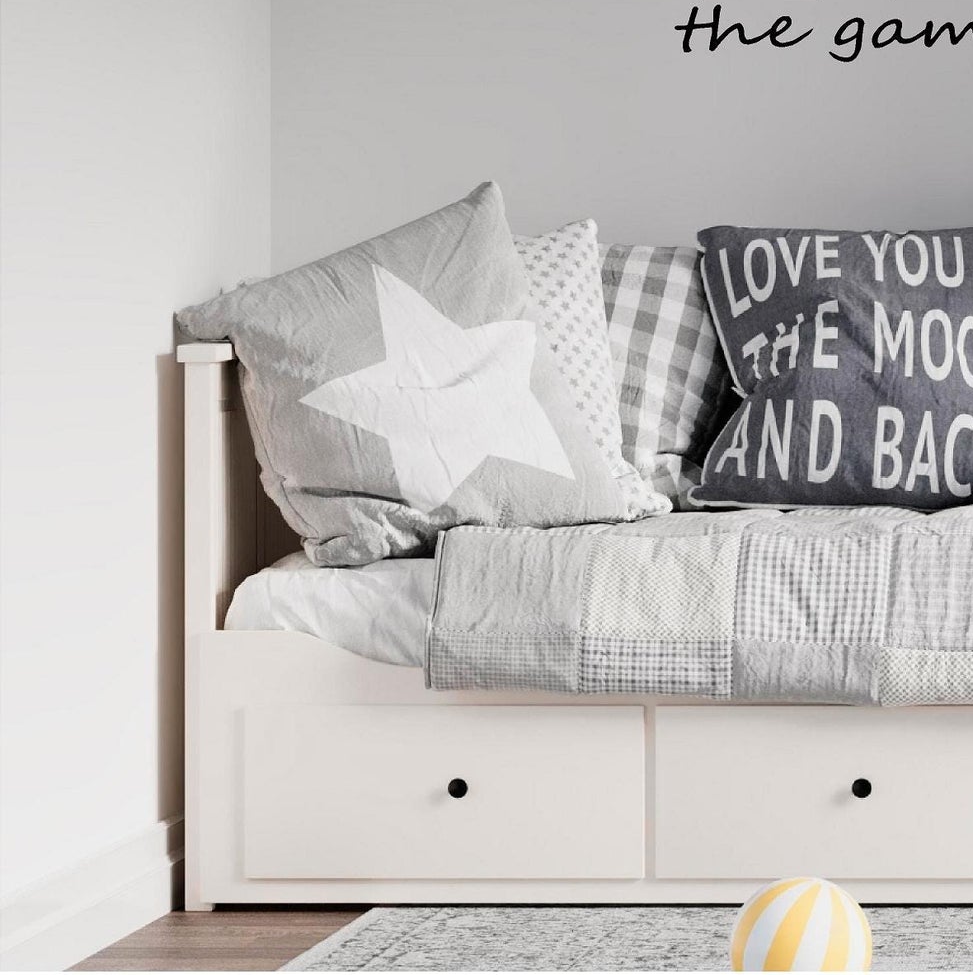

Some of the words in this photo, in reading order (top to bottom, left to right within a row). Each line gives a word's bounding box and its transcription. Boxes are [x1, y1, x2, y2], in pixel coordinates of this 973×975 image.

[674, 4, 813, 52] the
[719, 235, 841, 317] LOVE
[862, 233, 965, 288] YOU
[742, 300, 839, 379] THE
[715, 399, 842, 482] AND
